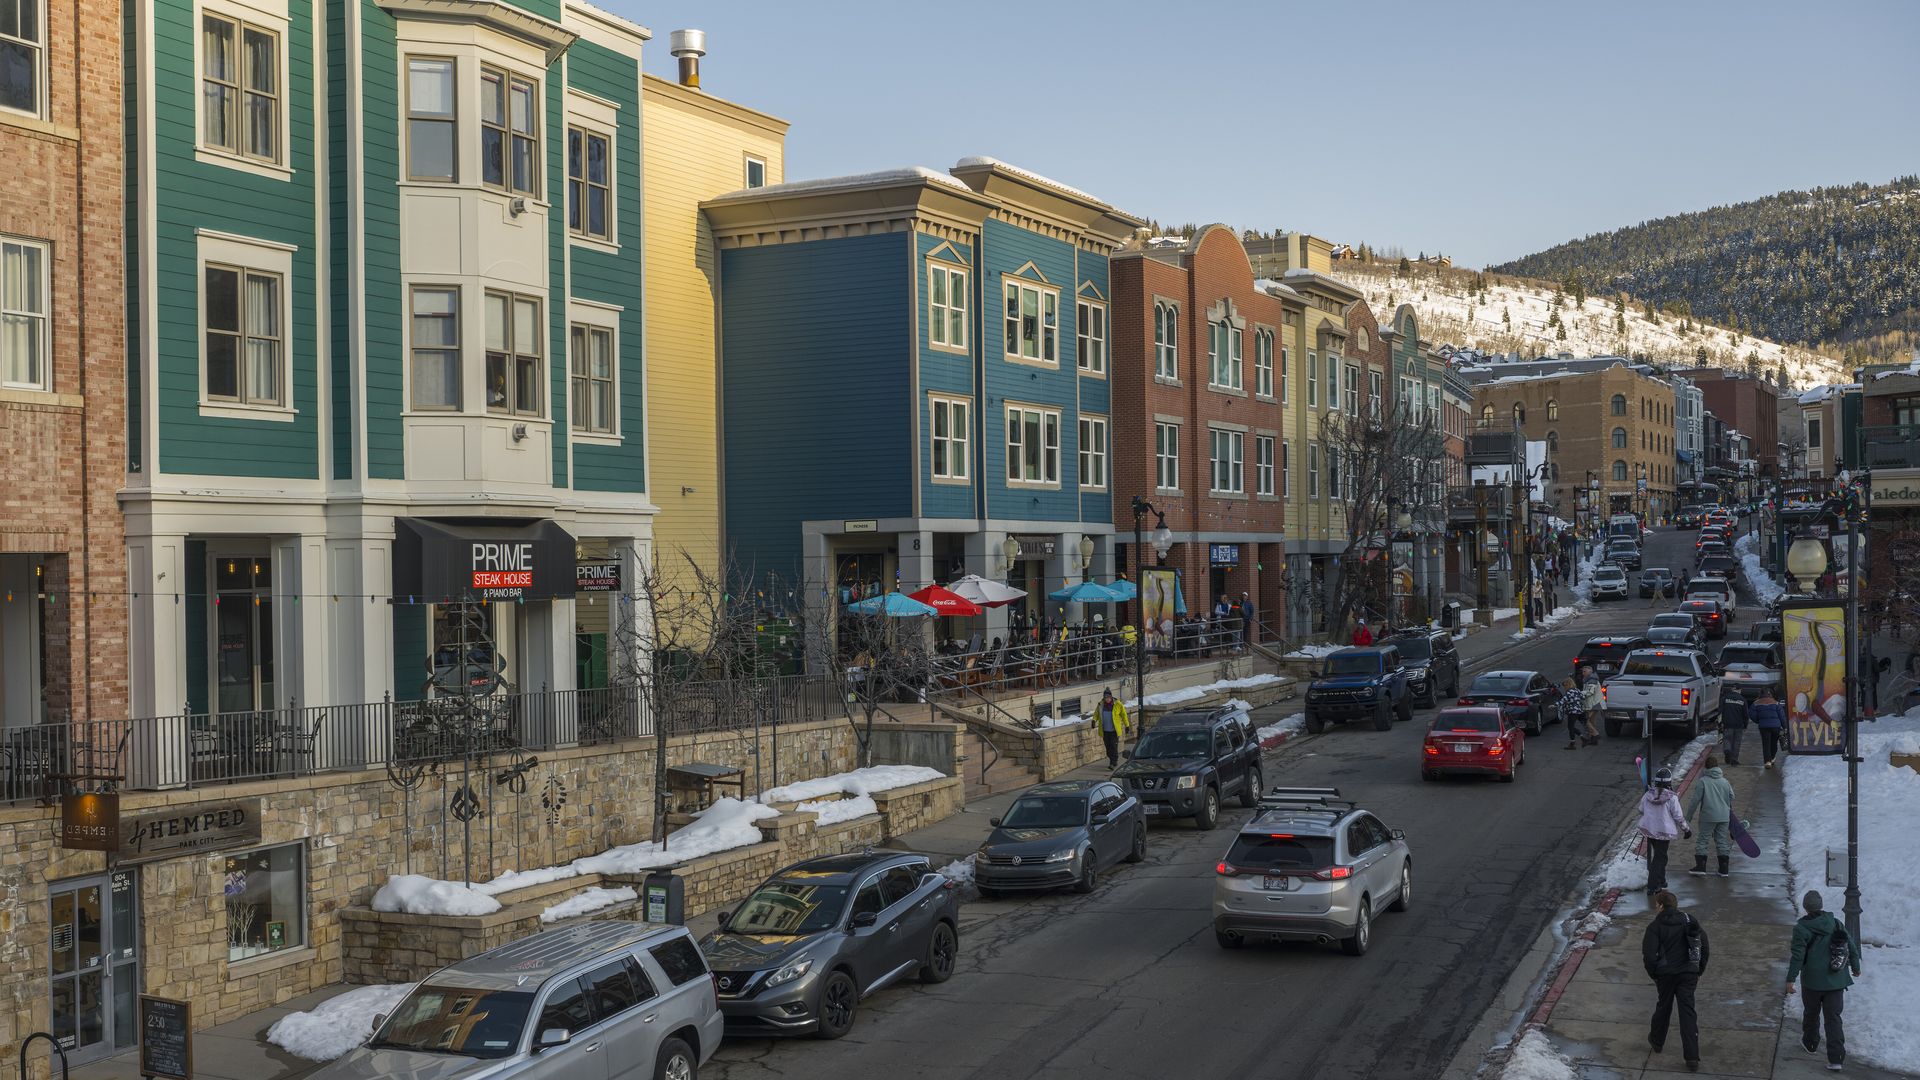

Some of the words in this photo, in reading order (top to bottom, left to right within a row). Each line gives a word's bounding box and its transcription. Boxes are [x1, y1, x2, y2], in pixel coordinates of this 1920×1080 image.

[913, 539, 920, 550] 8
[472, 543, 532, 571] PRIME
[576, 565, 616, 579] PRIME
[474, 573, 501, 585] STEAK
[503, 572, 531, 584] HOUSE
[577, 578, 595, 586] STEAK
[483, 589, 488, 598] &
[489, 588, 508, 598] PIANO
[509, 588, 523, 597] BAR
[1792, 720, 1842, 747] STYLE
[150, 809, 245, 839] HEMPED
[179, 841, 197, 849] PARK
[200, 837, 215, 847] CITY
[114, 873, 126, 881] 804
